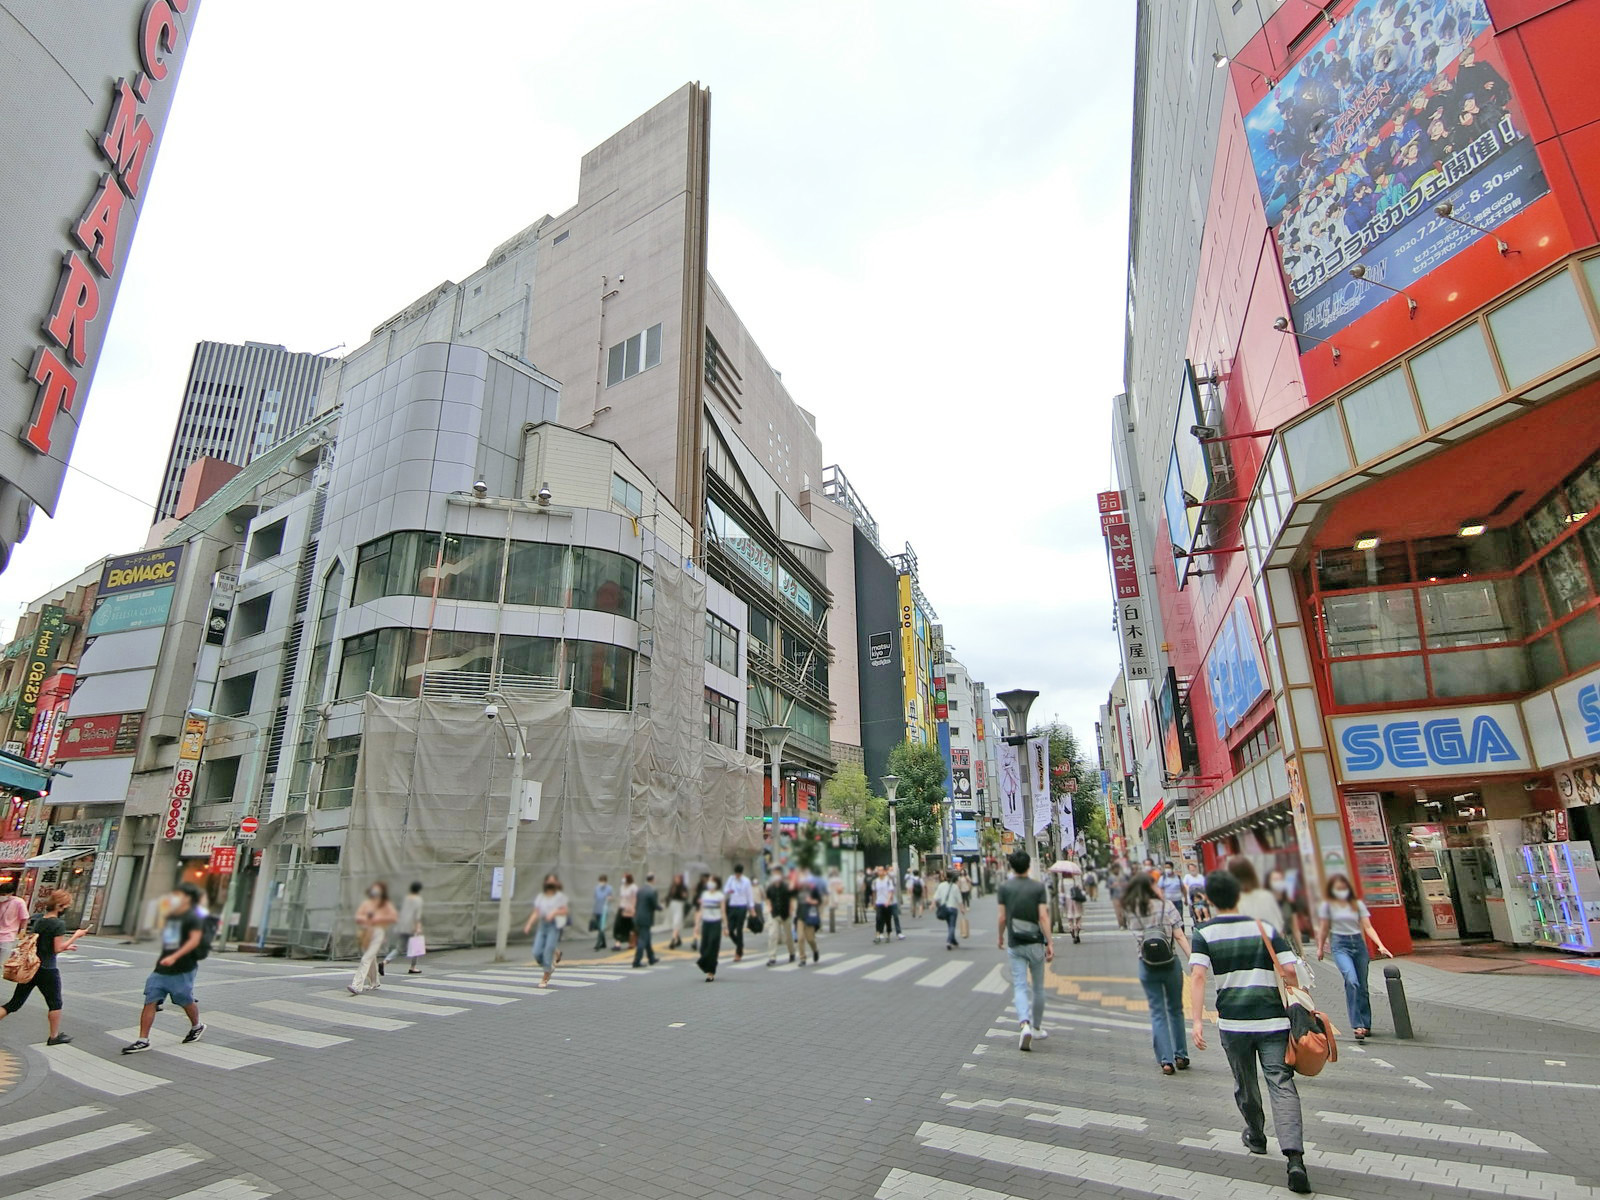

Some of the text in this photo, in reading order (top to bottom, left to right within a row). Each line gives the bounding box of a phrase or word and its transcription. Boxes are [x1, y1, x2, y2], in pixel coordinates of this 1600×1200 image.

[107, 560, 176, 588] BIGMAGIC
[36, 630, 54, 657] Hotel
[1124, 604, 1146, 658] 白木屋
[871, 643, 891, 652] matsu
[1341, 714, 1521, 772] SEGA
